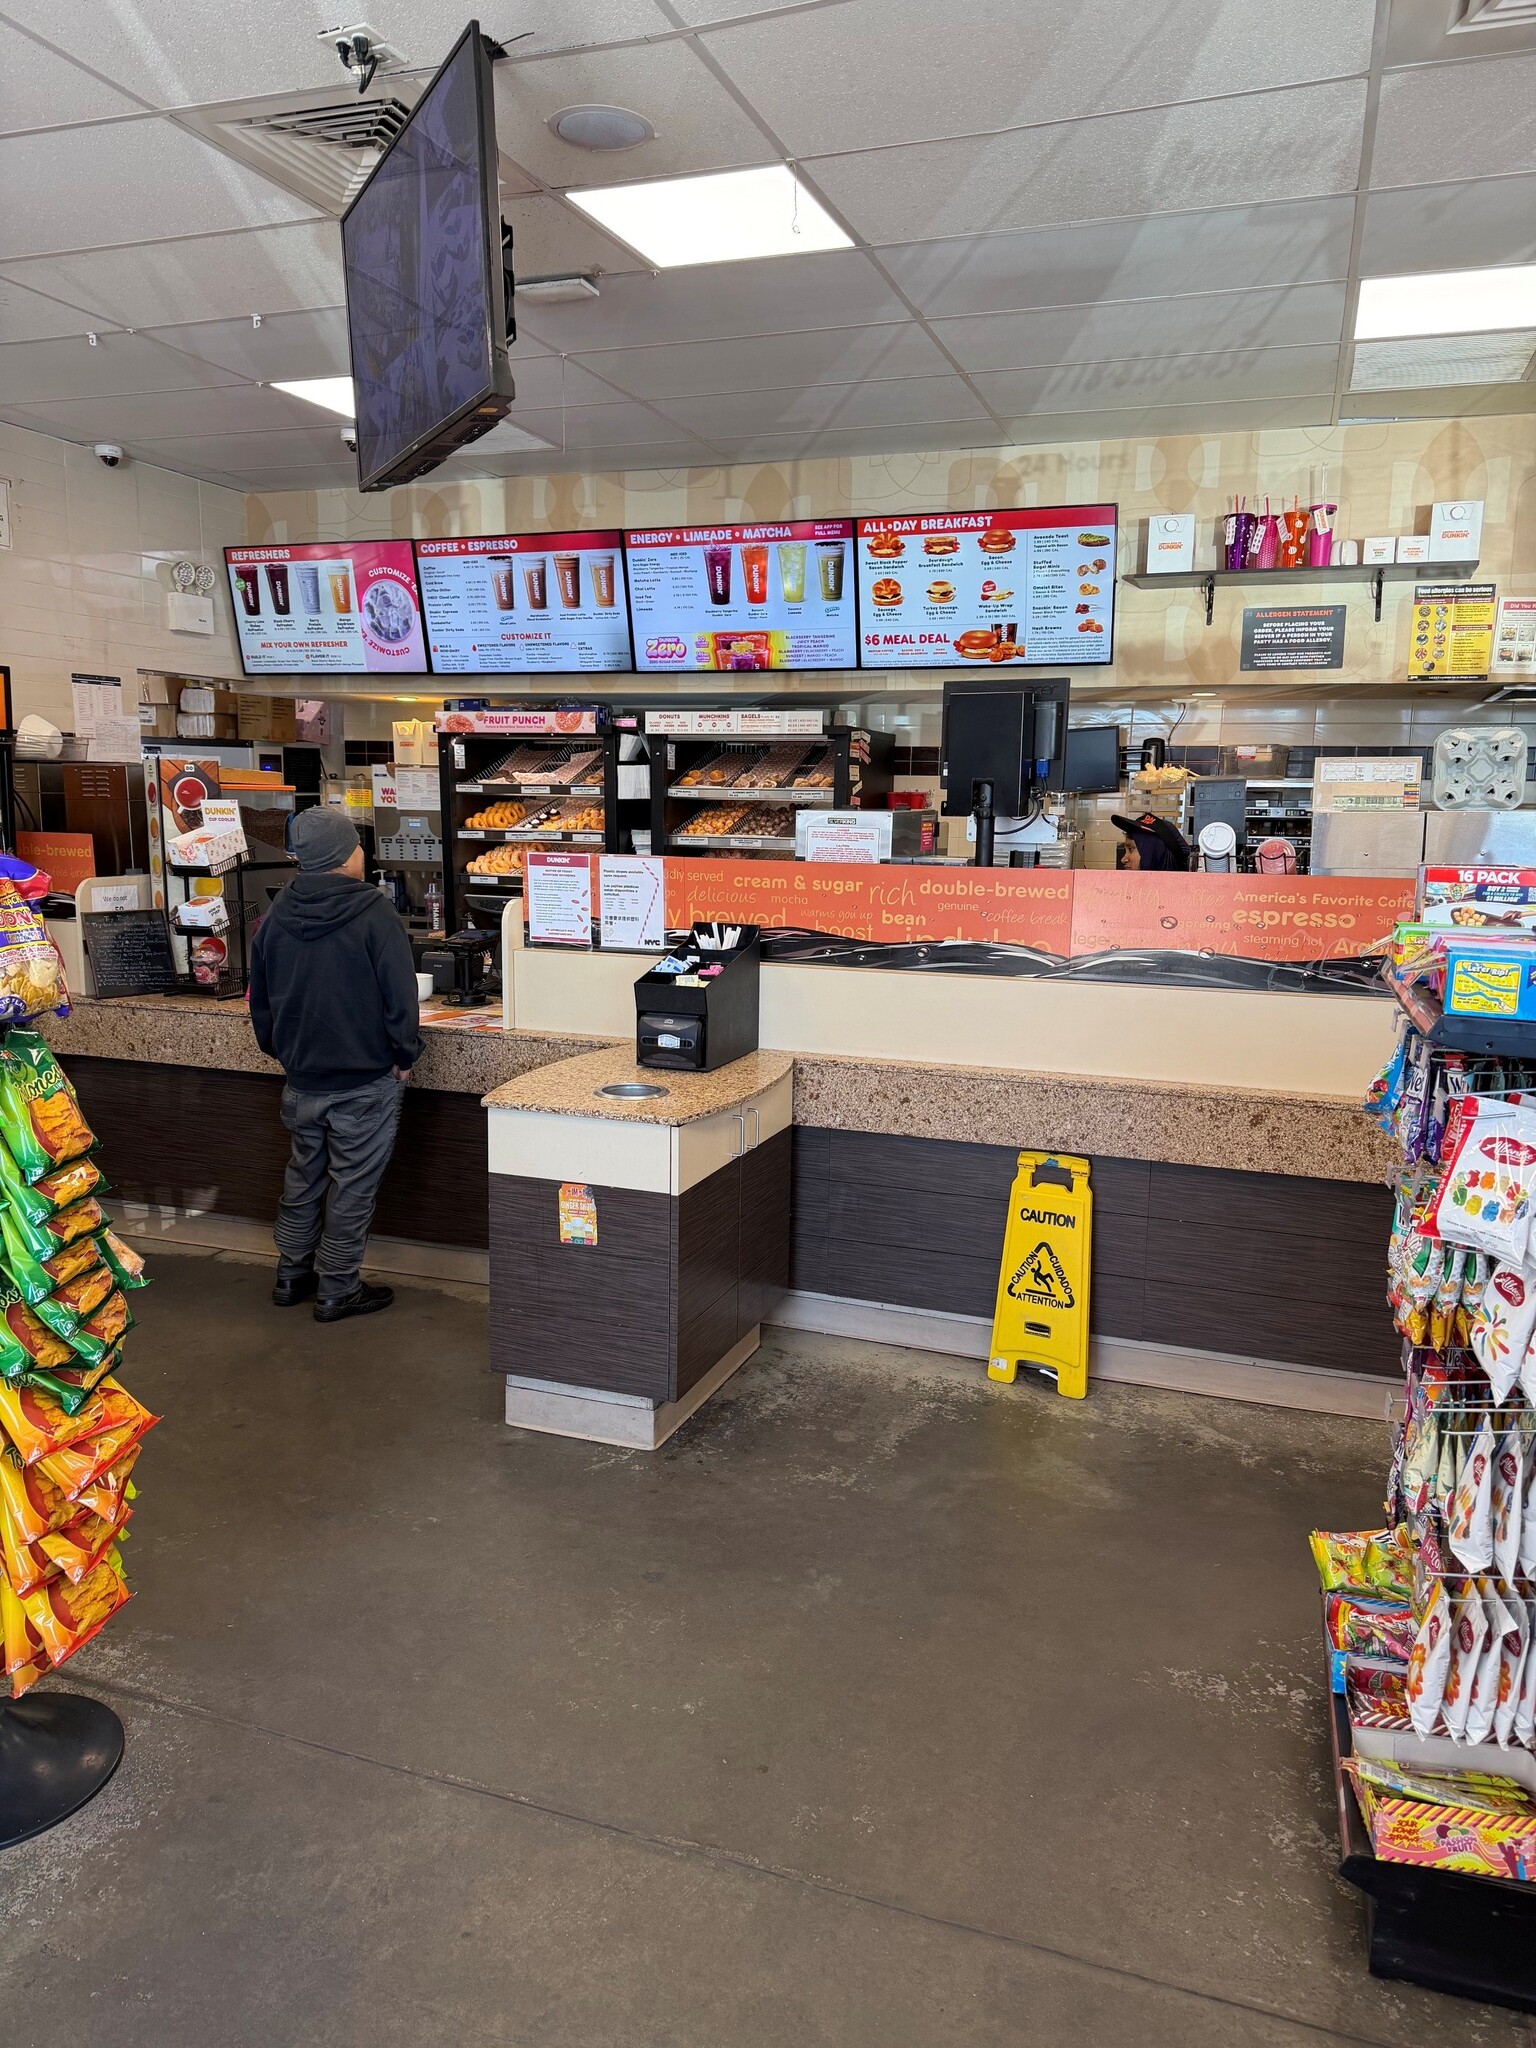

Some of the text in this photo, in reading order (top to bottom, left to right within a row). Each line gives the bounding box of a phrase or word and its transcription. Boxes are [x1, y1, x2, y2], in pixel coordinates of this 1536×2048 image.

[920, 516, 993, 530] BREAKFAST
[630, 526, 792, 545] ENERGY LIMEADE MATCHA
[232, 549, 290, 561] REFRESHERS
[421, 540, 518, 554] COFFEE ESPRESSO
[368, 566, 411, 584] CUSTOMIZE
[752, 564, 760, 594] DUNKIN'
[276, 580, 284, 606] DUNKIN'
[336, 578, 345, 604] DUNKIN'
[499, 573, 508, 602] DUNKIN'
[532, 572, 540, 601] DUNKIN'
[565, 572, 573, 600] DUNKIN'
[246, 582, 255, 608] DUNKIN'
[368, 640, 410, 656] CUSTOMIZE
[646, 638, 686, 658] Zero
[865, 634, 950, 646] $6 MEAL DEAL
[1026, 686, 1060, 695] acer
[484, 716, 545, 724] FRUIT PUNCH
[204, 806, 236, 816] DUNKIN'
[688, 870, 724, 882] served
[734, 875, 863, 894] cream & sugar
[1458, 870, 1520, 884] 16 PACK
[688, 886, 757, 904] delicious
[869, 878, 916, 906] rich
[920, 879, 1069, 899] double-brewed
[771, 894, 809, 905] mocha
[938, 902, 979, 912] genuine
[1232, 891, 1414, 909] America's Favorite Coffe
[800, 909, 874, 923] warms you up
[882, 910, 926, 926] bean
[986, 909, 1069, 925] coffee break
[1232, 909, 1356, 930] espresso
[815, 920, 874, 940] boost
[1244, 935, 1322, 947] steaming hot
[1467, 964, 1510, 977] Let'er Rip!
[1433, 1178, 1447, 1210] FLAVOR
[1020, 1208, 1075, 1229] CAUTION
[1011, 1251, 1038, 1284] CAUTION
[1050, 1255, 1072, 1295] CUIDADO
[1016, 1294, 1064, 1309] ATTENTION
[1388, 1834, 1420, 1842] STRAWS
[1440, 1835, 1477, 1847] PASSION
[1447, 1843, 1473, 1853] FRUIT
